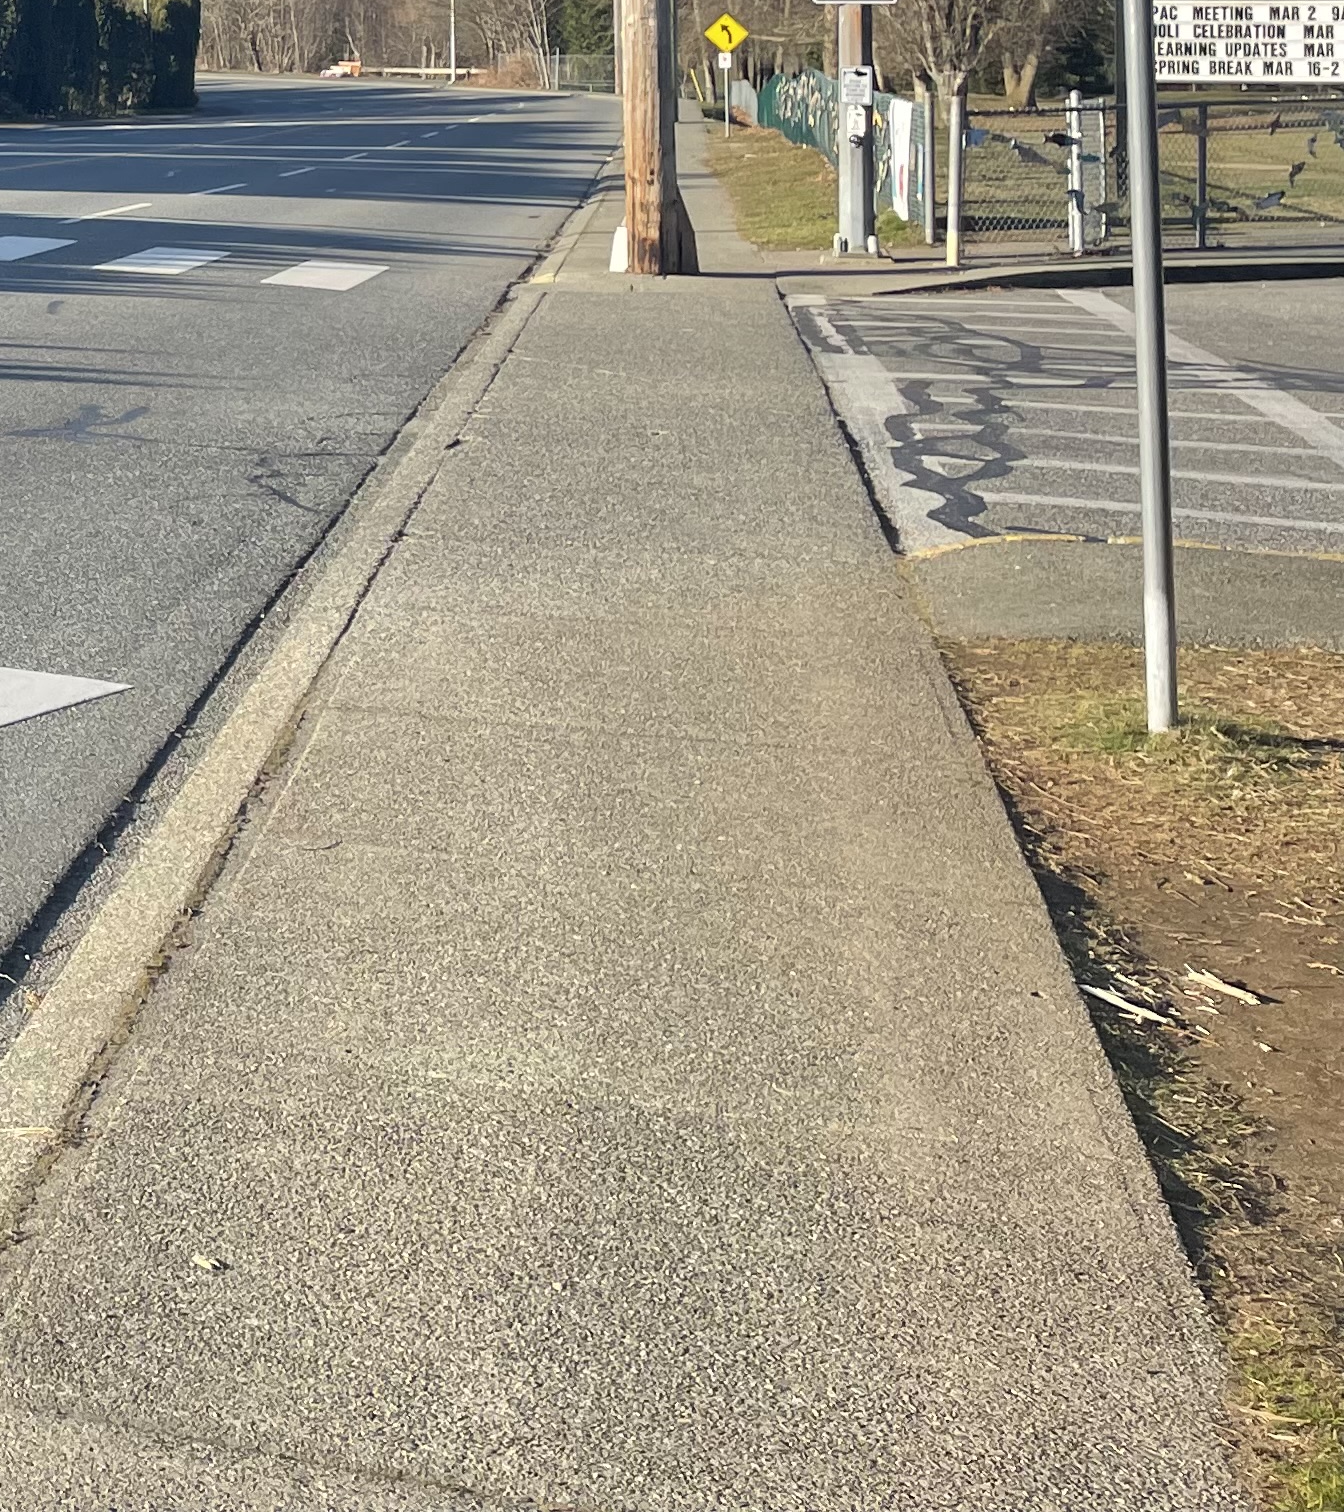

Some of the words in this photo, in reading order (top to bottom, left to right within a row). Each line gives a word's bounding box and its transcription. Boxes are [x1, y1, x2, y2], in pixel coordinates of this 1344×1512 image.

[1193, 5, 1253, 21] MEETING
[1269, 6, 1300, 21] MAR
[1308, 6, 1317, 21] 2
[1193, 24, 1286, 39] CELEBRATION
[1303, 25, 1334, 40] MAR
[1155, 42, 1217, 57] EARNING
[1225, 43, 1287, 58] UPDATES
[1303, 43, 1334, 58] MAR
[1209, 61, 1253, 76] BREAK
[1263, 61, 1293, 76] MAR
[1308, 61, 1344, 77] 16-2
